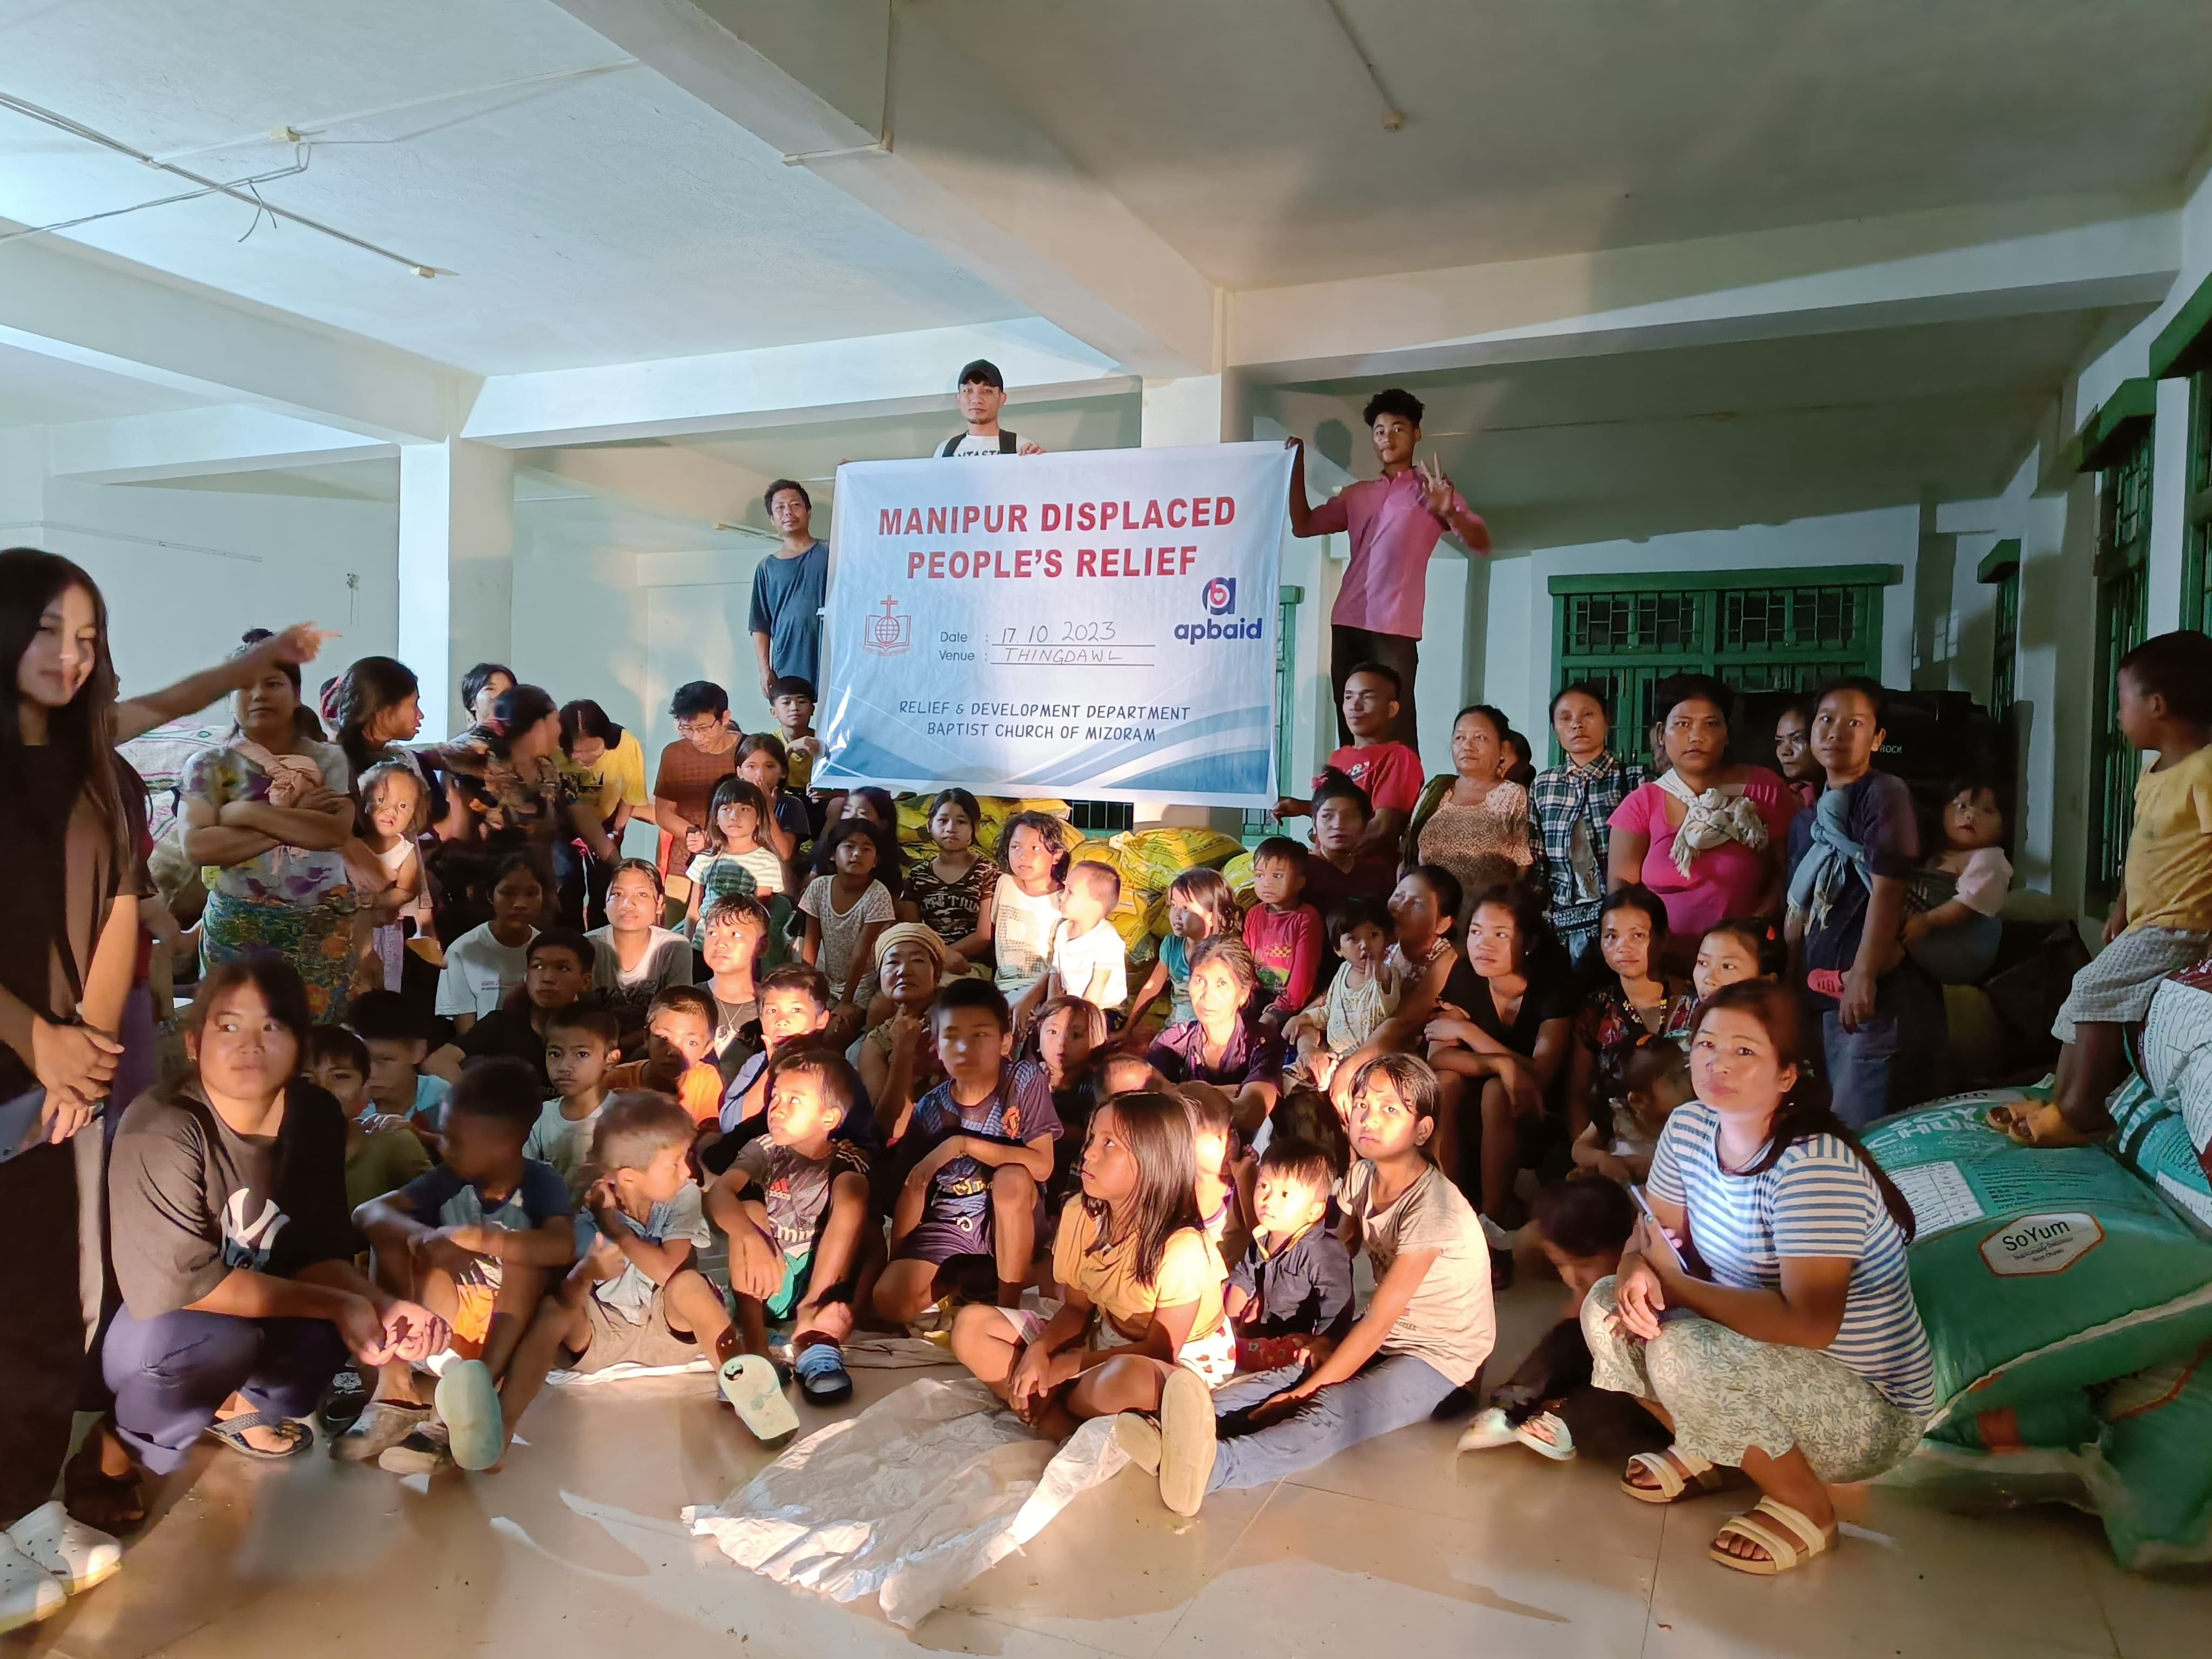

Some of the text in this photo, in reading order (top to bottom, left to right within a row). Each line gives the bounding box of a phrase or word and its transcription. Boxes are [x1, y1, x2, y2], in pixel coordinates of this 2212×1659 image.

[879, 496, 1236, 535] MANIPUR DISPLACED
[907, 545, 1197, 579] PEOPLE'S RELIEF
[940, 631, 968, 643] Date
[1062, 621, 1116, 642] 2023
[1174, 617, 1263, 645] apbaid
[939, 650, 975, 661] Venue
[1005, 648, 1123, 664] THINGDAWL
[900, 700, 1190, 720] RELIEF & DEVELOPMENT DEPARTMENT
[927, 722, 1156, 742] BAPTIST CHURCH OF MIZORAM
[1888, 1108, 1978, 1131] SOY
[2002, 1221, 2070, 1251] SoYum
